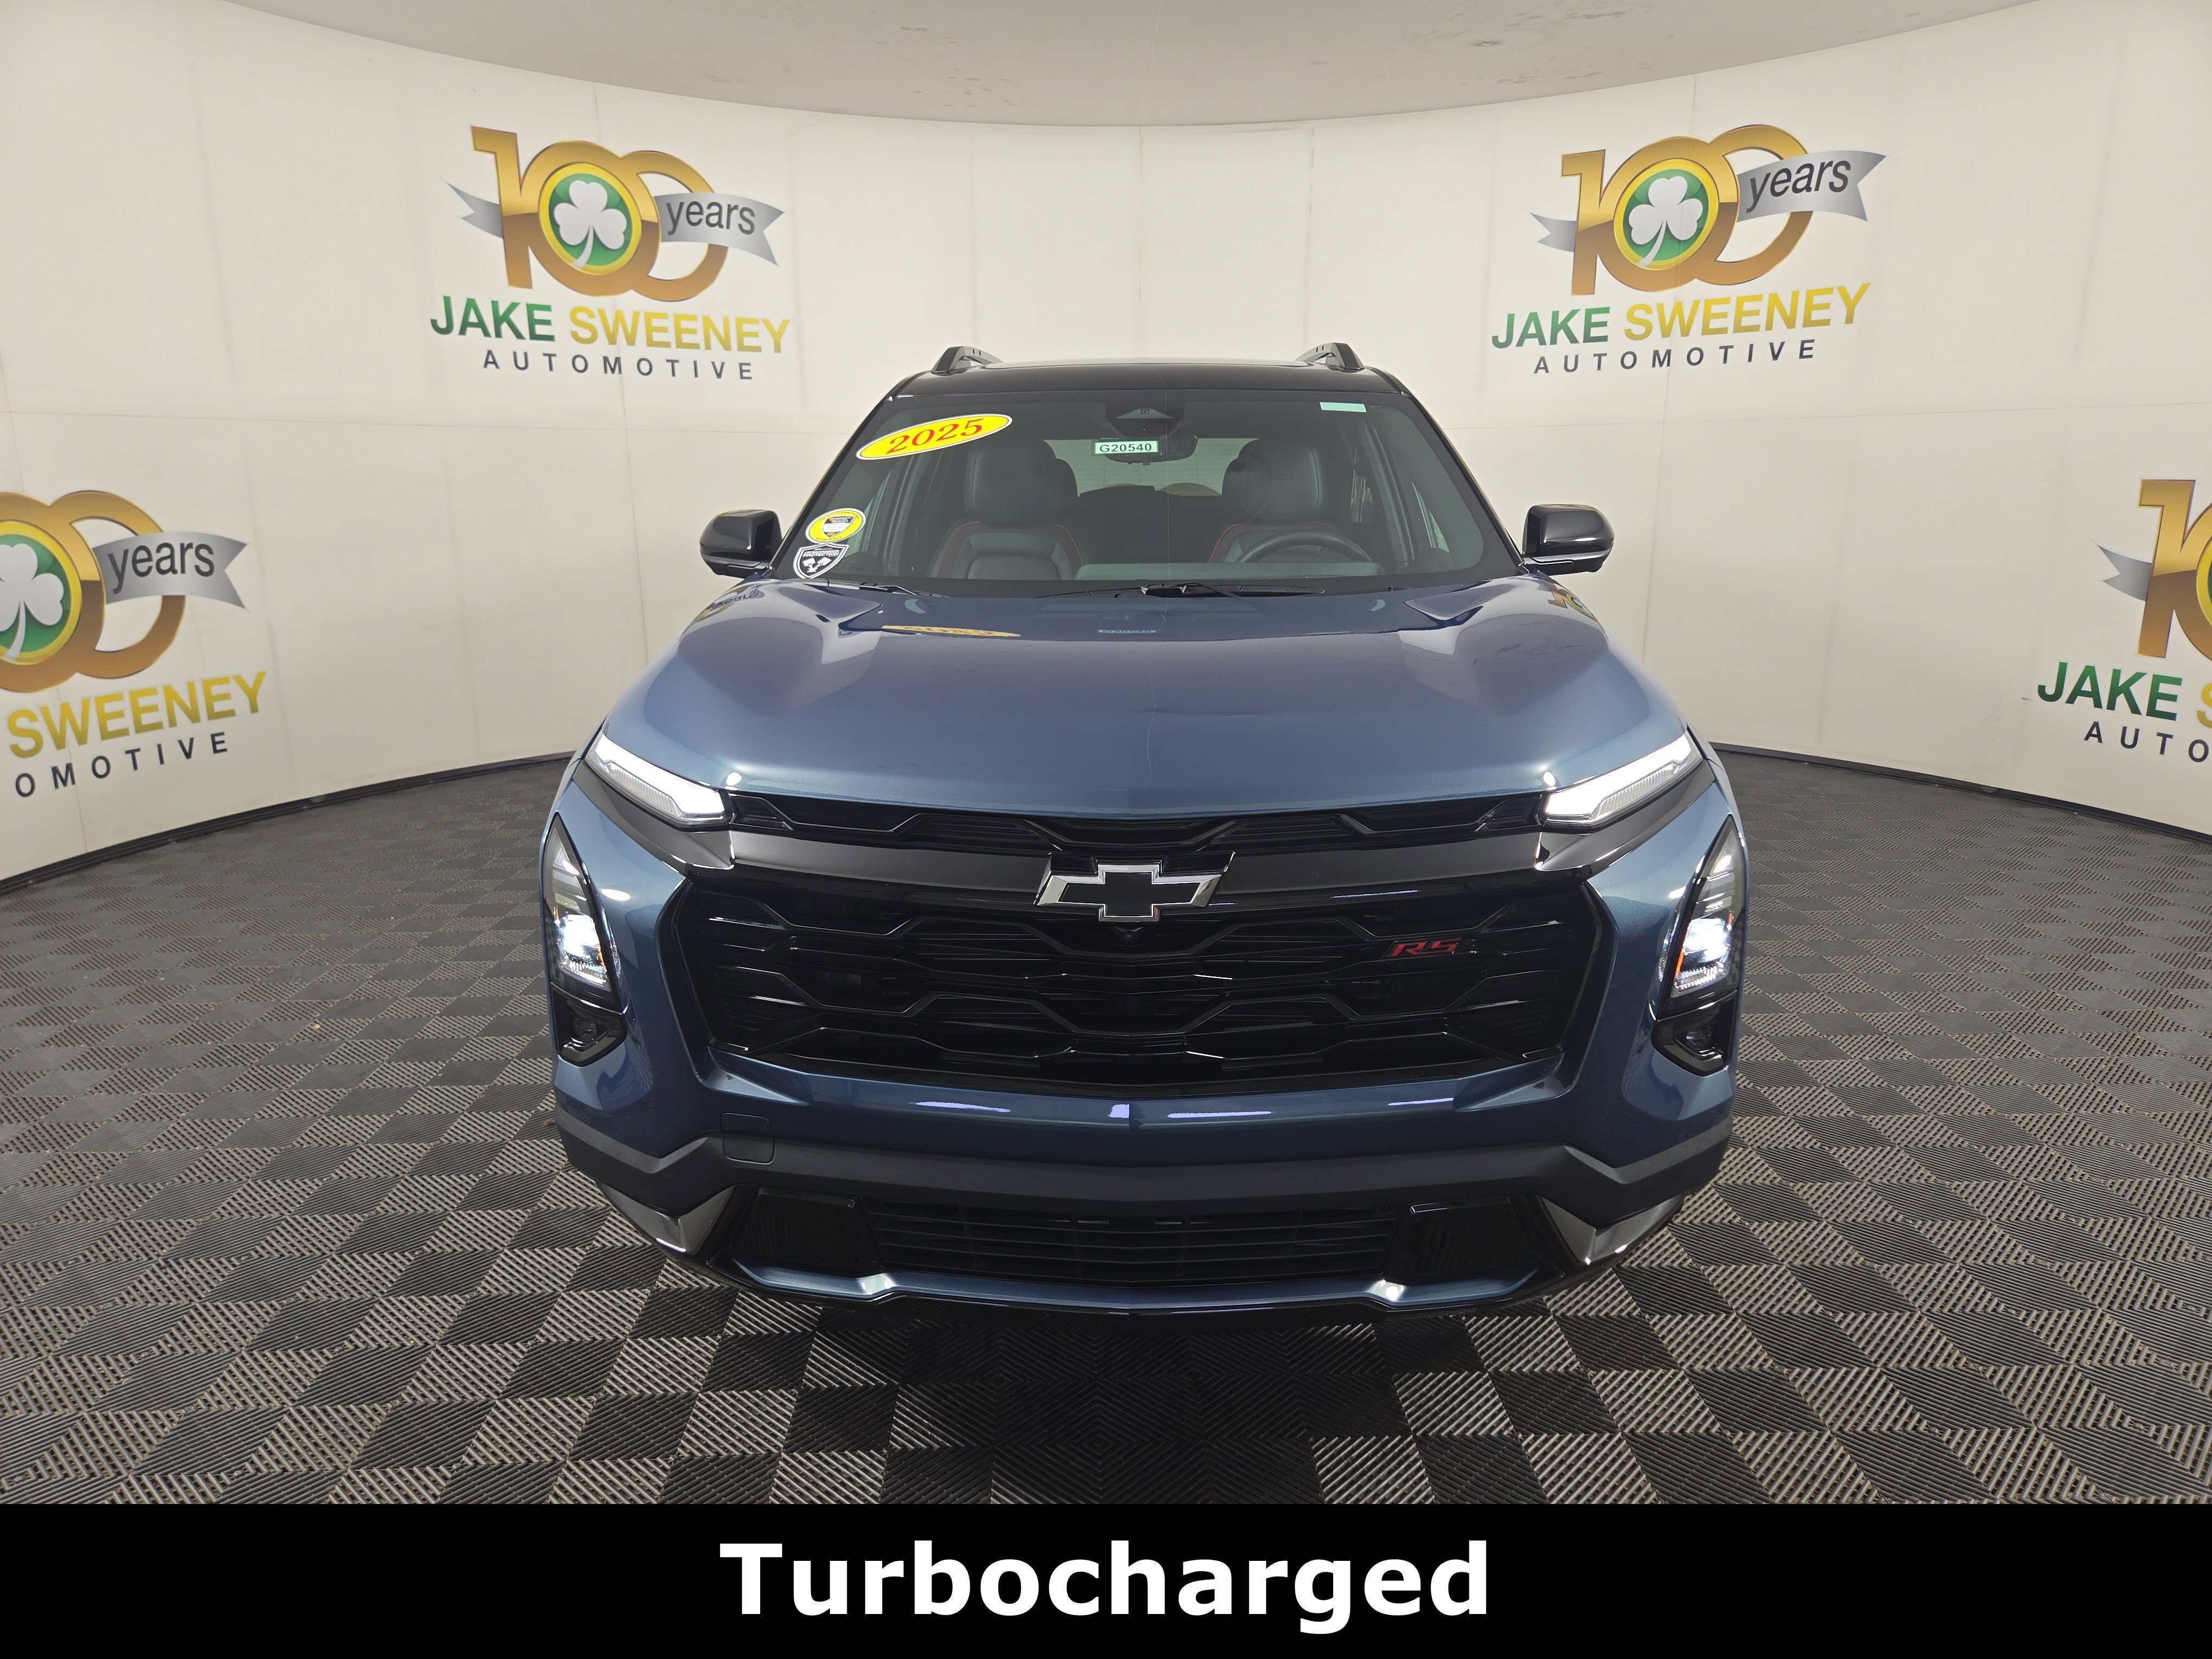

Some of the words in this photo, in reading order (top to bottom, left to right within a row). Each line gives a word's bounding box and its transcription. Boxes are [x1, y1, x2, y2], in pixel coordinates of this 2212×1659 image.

[1746, 158, 1851, 213] years
[665, 200, 756, 236] years
[430, 295, 555, 342] JAKE
[569, 306, 790, 353] SWEENEY
[1491, 307, 1610, 349] JAKE
[1624, 283, 1871, 341] SWEENEY
[484, 350, 753, 380] AUTOMOTIVE
[1534, 339, 1815, 374] AUTOMOTIVE
[886, 418, 985, 454] 2025
[1099, 443, 1152, 452] G20540
[108, 542, 215, 594] years
[2037, 661, 2183, 721] JAKE
[7, 671, 267, 758] SWEENEY
[2084, 721, 2209, 762] AUTO
[15, 732, 228, 798] OMOTIVE
[1390, 937, 1462, 957] RS
